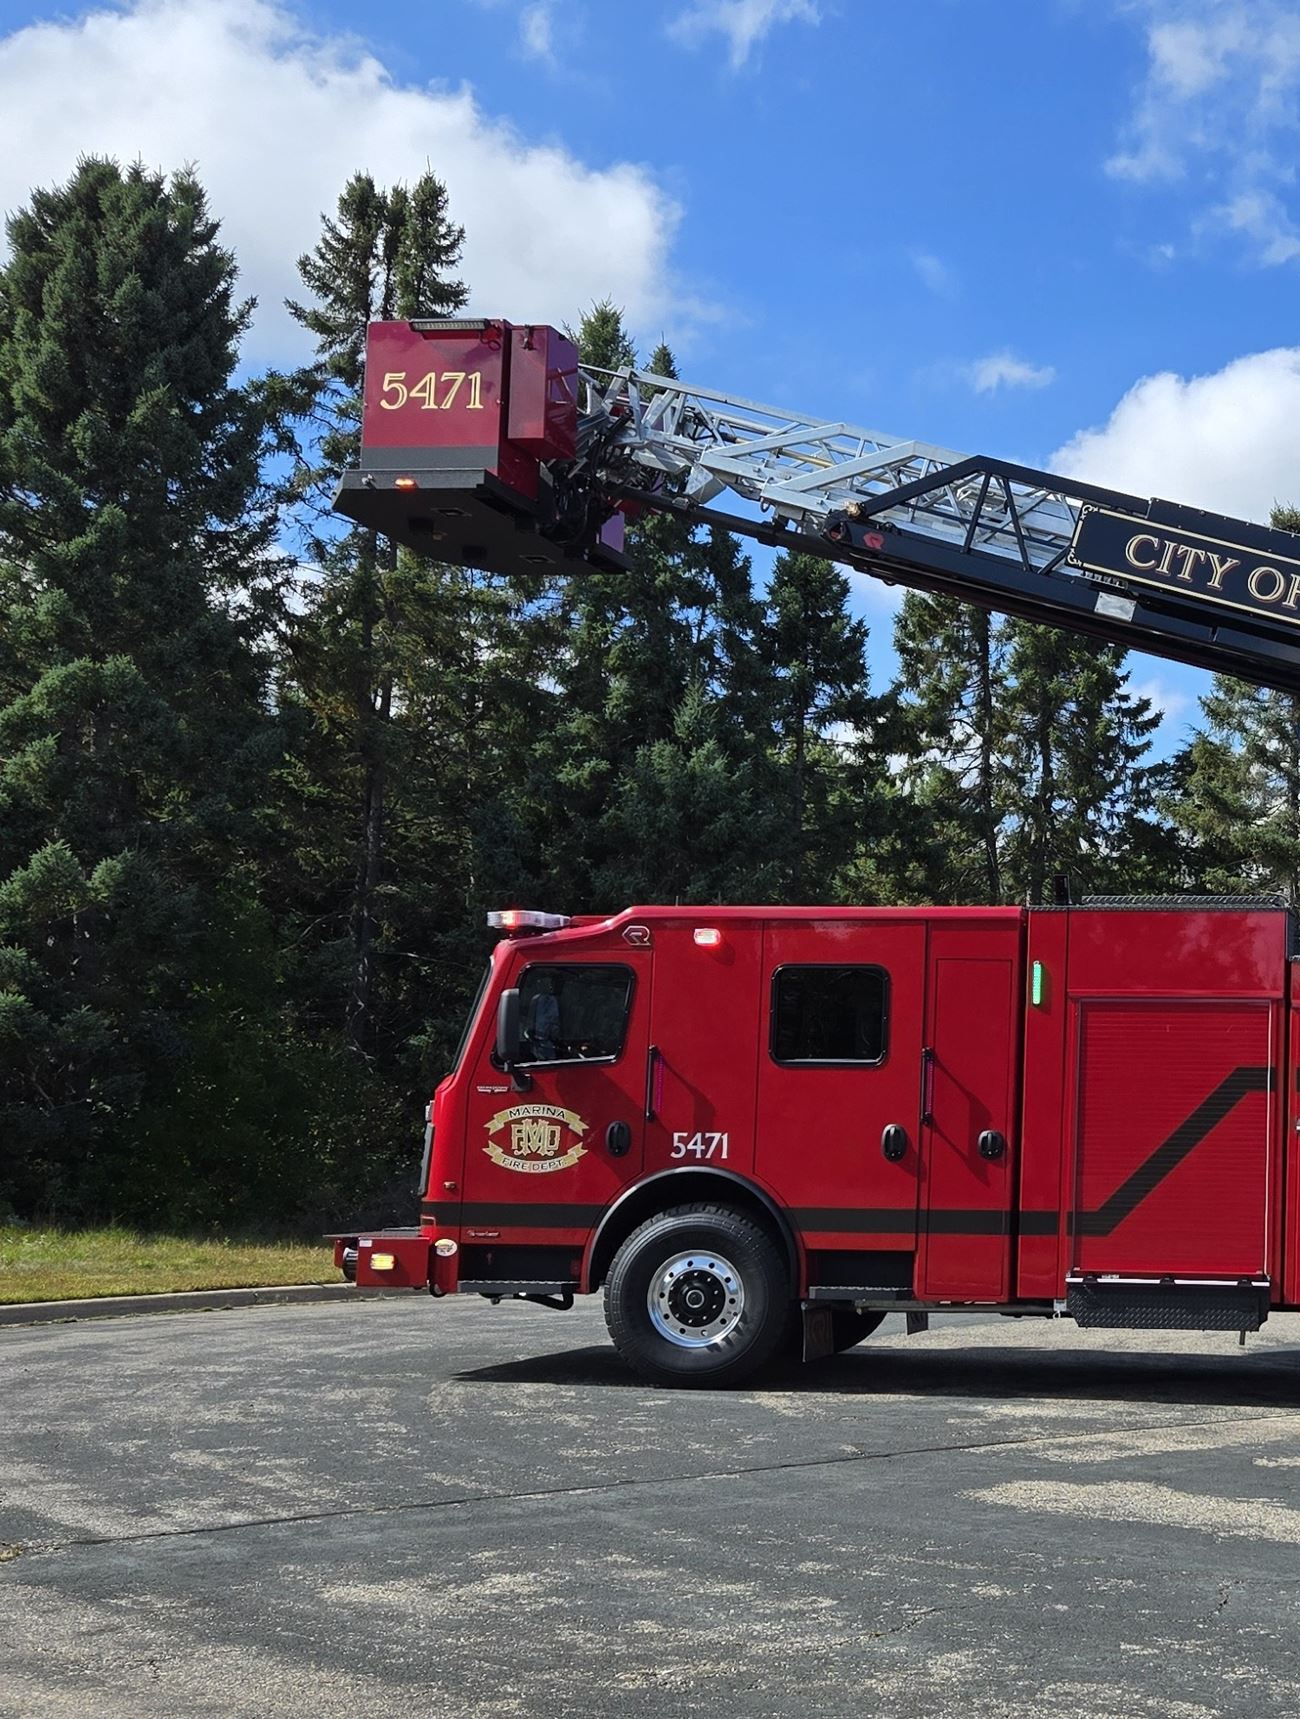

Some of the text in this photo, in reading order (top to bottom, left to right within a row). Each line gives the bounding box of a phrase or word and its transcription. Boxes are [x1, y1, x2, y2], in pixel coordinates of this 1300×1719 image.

[380, 371, 484, 410] 5471
[1125, 533, 1241, 591] CITY
[508, 1105, 567, 1120] MARINA
[670, 1131, 729, 1160] 5471
[502, 1156, 530, 1171] FIRE
